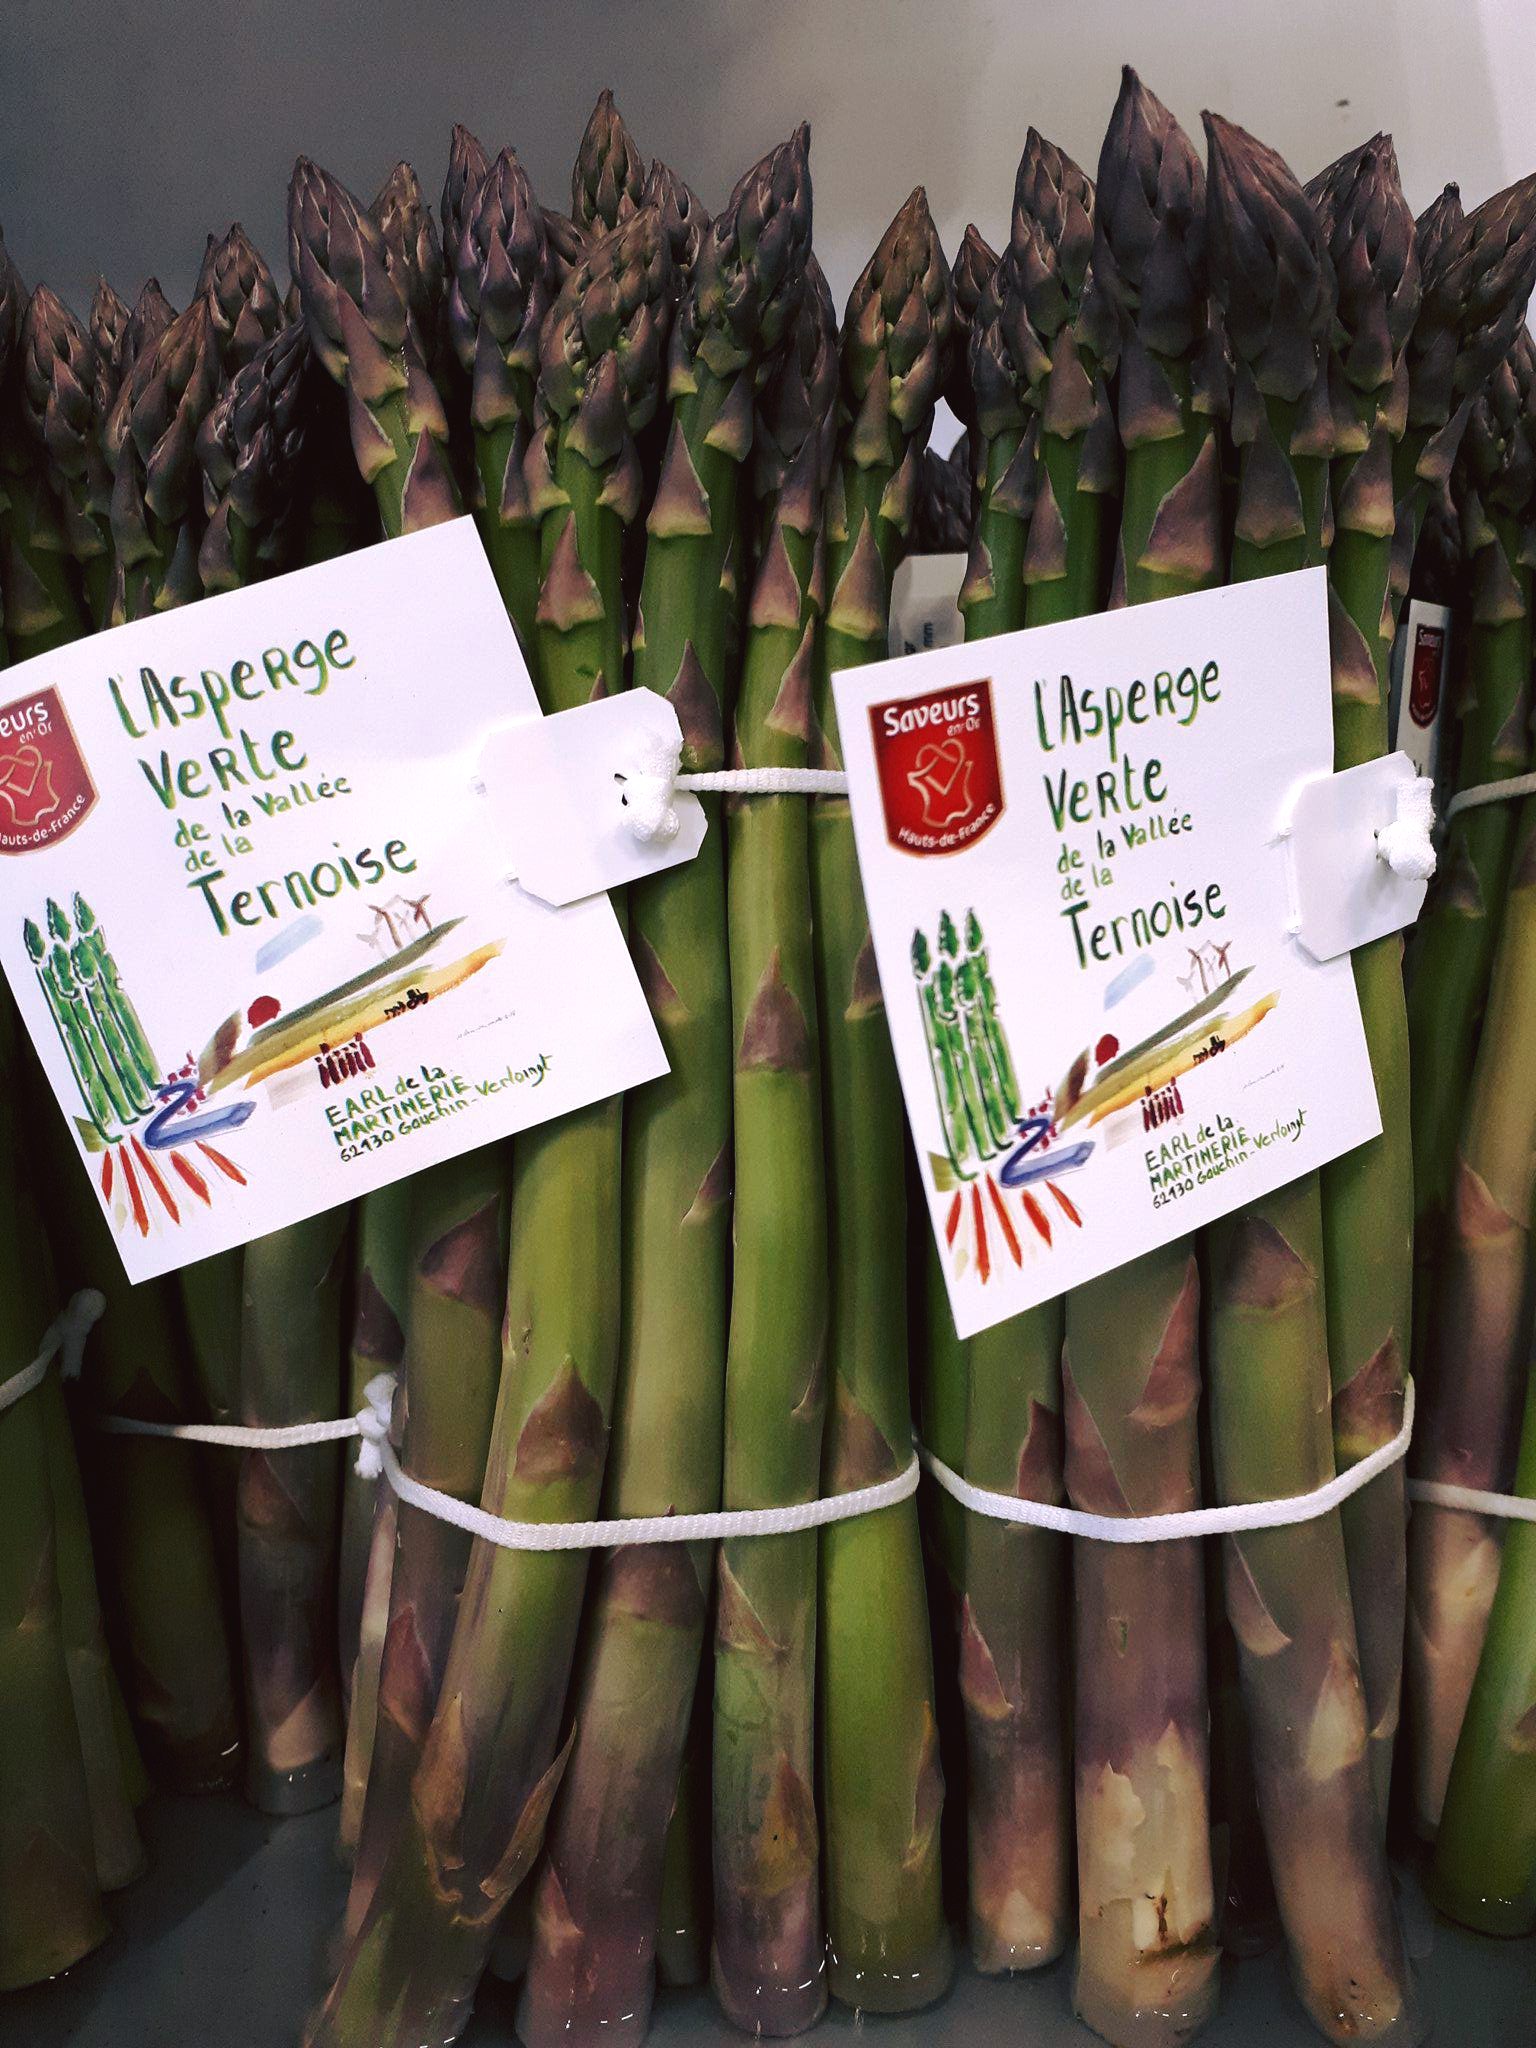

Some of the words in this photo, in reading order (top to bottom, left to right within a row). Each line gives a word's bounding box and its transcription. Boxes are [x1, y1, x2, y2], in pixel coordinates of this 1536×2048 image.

[0, 702, 49, 737] eurs
[883, 693, 980, 737] Saveurs
[0, 793, 86, 846] auts-de-France
[174, 818, 211, 848] de
[222, 802, 252, 829] la
[898, 803, 996, 848] Hauts-de-France
[184, 848, 218, 872] de
[222, 833, 254, 856] la
[1056, 843, 1085, 874] de
[1097, 829, 1116, 860] la
[187, 839, 418, 936] Ternoise
[1060, 877, 1087, 900] de
[1092, 862, 1114, 888] la
[1060, 881, 1227, 969] Ternoise
[324, 1084, 395, 1127] EARL
[395, 1075, 420, 1095] de
[333, 1075, 472, 1147] MARTINERIE
[1144, 1132, 1197, 1172] EARL
[1196, 1124, 1216, 1144] de
[1150, 1127, 1250, 1193] MARTINERIE
